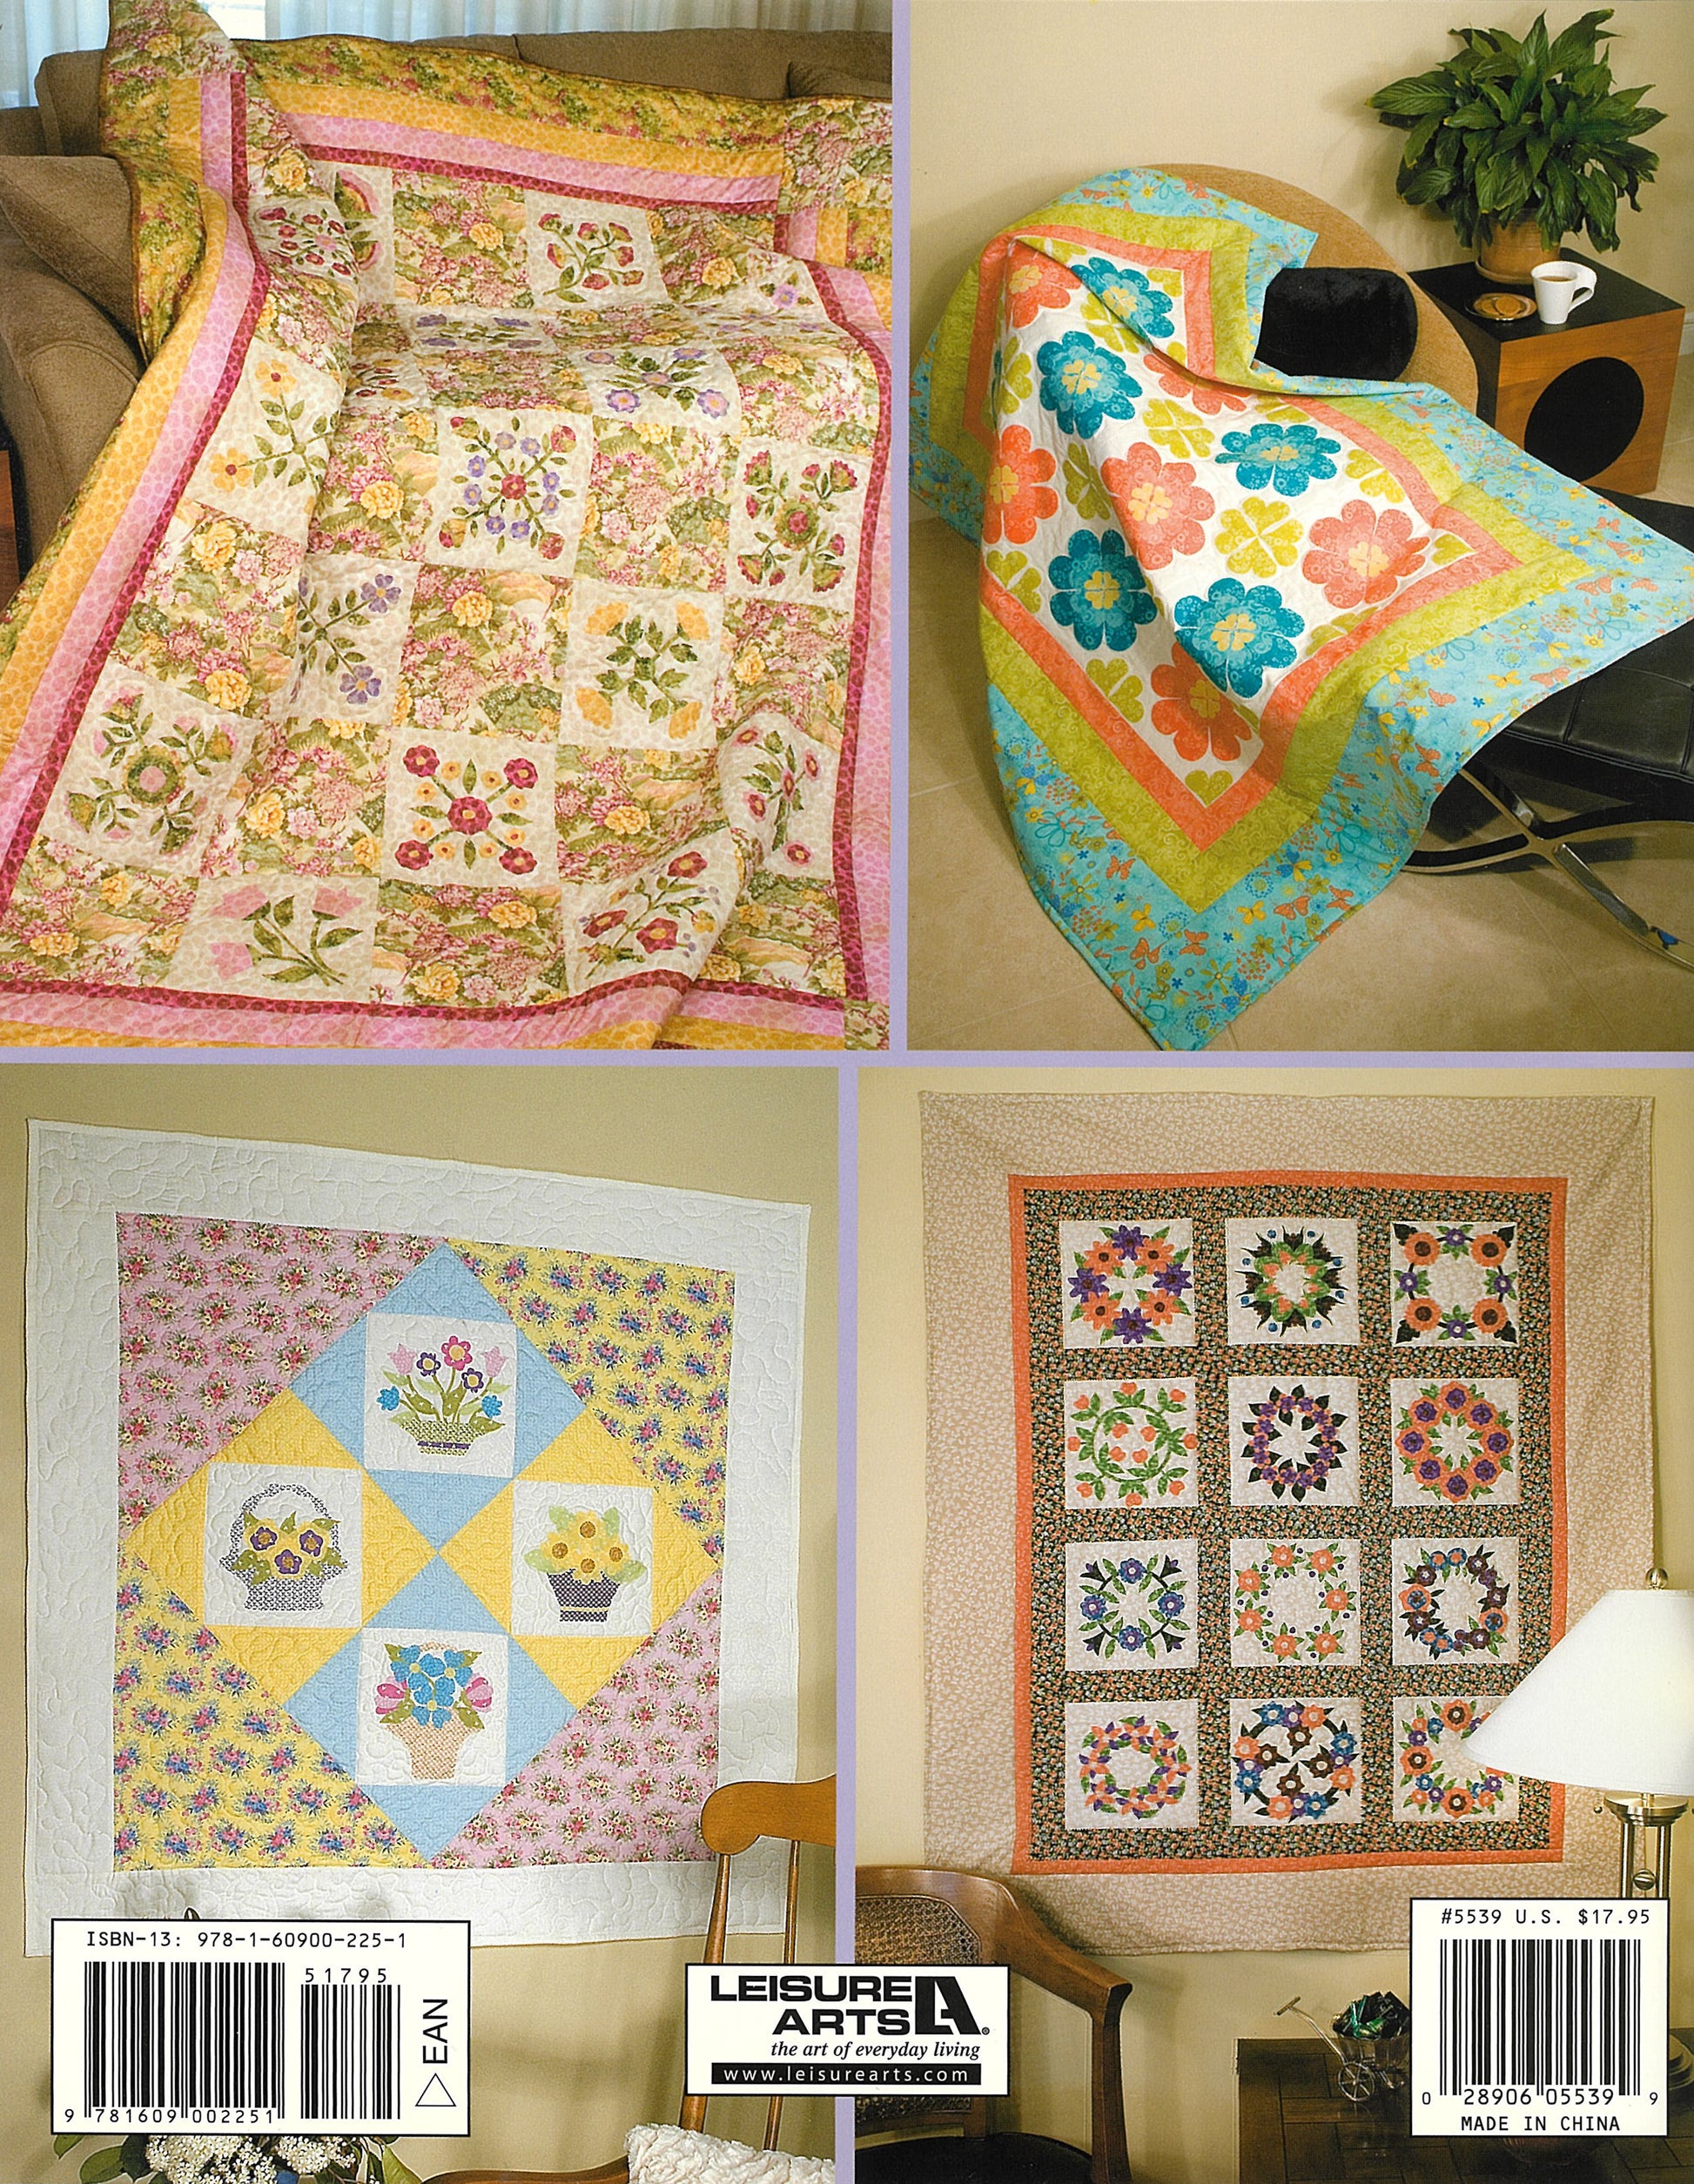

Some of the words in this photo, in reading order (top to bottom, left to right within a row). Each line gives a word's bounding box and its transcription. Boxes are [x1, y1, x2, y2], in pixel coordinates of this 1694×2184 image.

[1441, 1908, 1502, 1925] #5539
[1516, 1909, 1562, 1925] U.S.
[1578, 1908, 1650, 1925] $17.95
[87, 1931, 182, 1948] ISBN-13:
[197, 1932, 407, 1949] 978-1-60900-225-1
[305, 1967, 388, 1984] 51795
[710, 1975, 912, 2002] LEISURE
[771, 2008, 911, 2035] ARTS
[422, 1999, 448, 2064] EAN
[770, 2041, 798, 2057] the
[803, 2043, 829, 2057] art
[833, 2041, 854, 2060] of
[855, 2042, 928, 2061] everyday
[933, 2041, 981, 2060] living
[723, 2066, 969, 2082] www.leisurearts.com
[1422, 2092, 1431, 2105] 0
[1463, 2088, 1532, 2106] 28906
[1546, 2088, 1614, 2106] 05539
[1649, 2092, 1658, 2106] 9
[64, 2108, 74, 2123] 9
[95, 2108, 178, 2124] 781609
[192, 2108, 275, 2124] 002251
[1461, 2116, 1509, 2132] MADE
[1523, 2116, 1547, 2132] IN
[1560, 2116, 1621, 2132] CHINA
